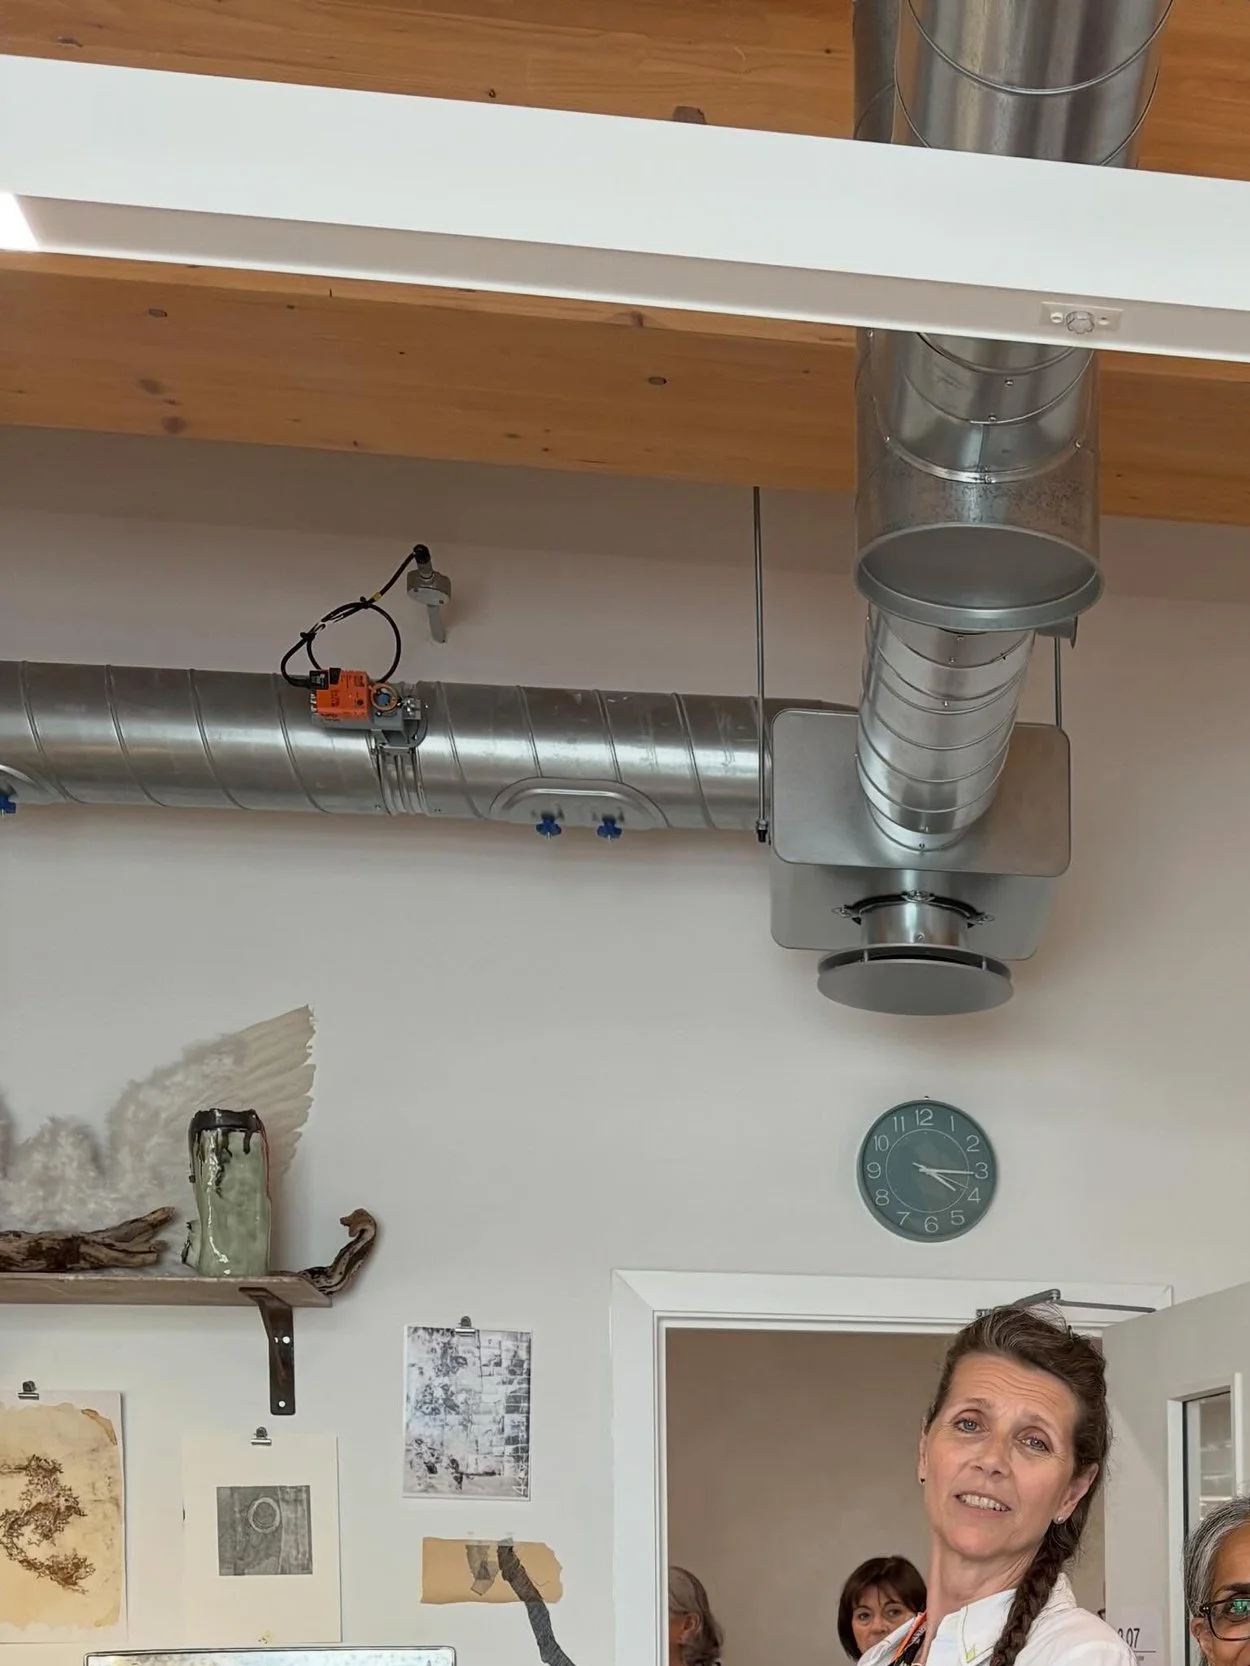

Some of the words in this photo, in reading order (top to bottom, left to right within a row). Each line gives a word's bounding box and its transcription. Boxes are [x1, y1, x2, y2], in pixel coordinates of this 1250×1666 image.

[893, 1116, 905, 1132] 11
[915, 1108, 934, 1126] 12
[950, 1115, 955, 1132] 1
[874, 1134, 889, 1151] 10
[966, 1135, 980, 1152] 2
[866, 1162, 881, 1179] 9
[974, 1161, 989, 1179] 3
[875, 1189, 890, 1206] 8
[967, 1187, 981, 1203] 4
[896, 1211, 911, 1225] 7
[924, 1216, 939, 1233] 6
[950, 1210, 965, 1226] 5
